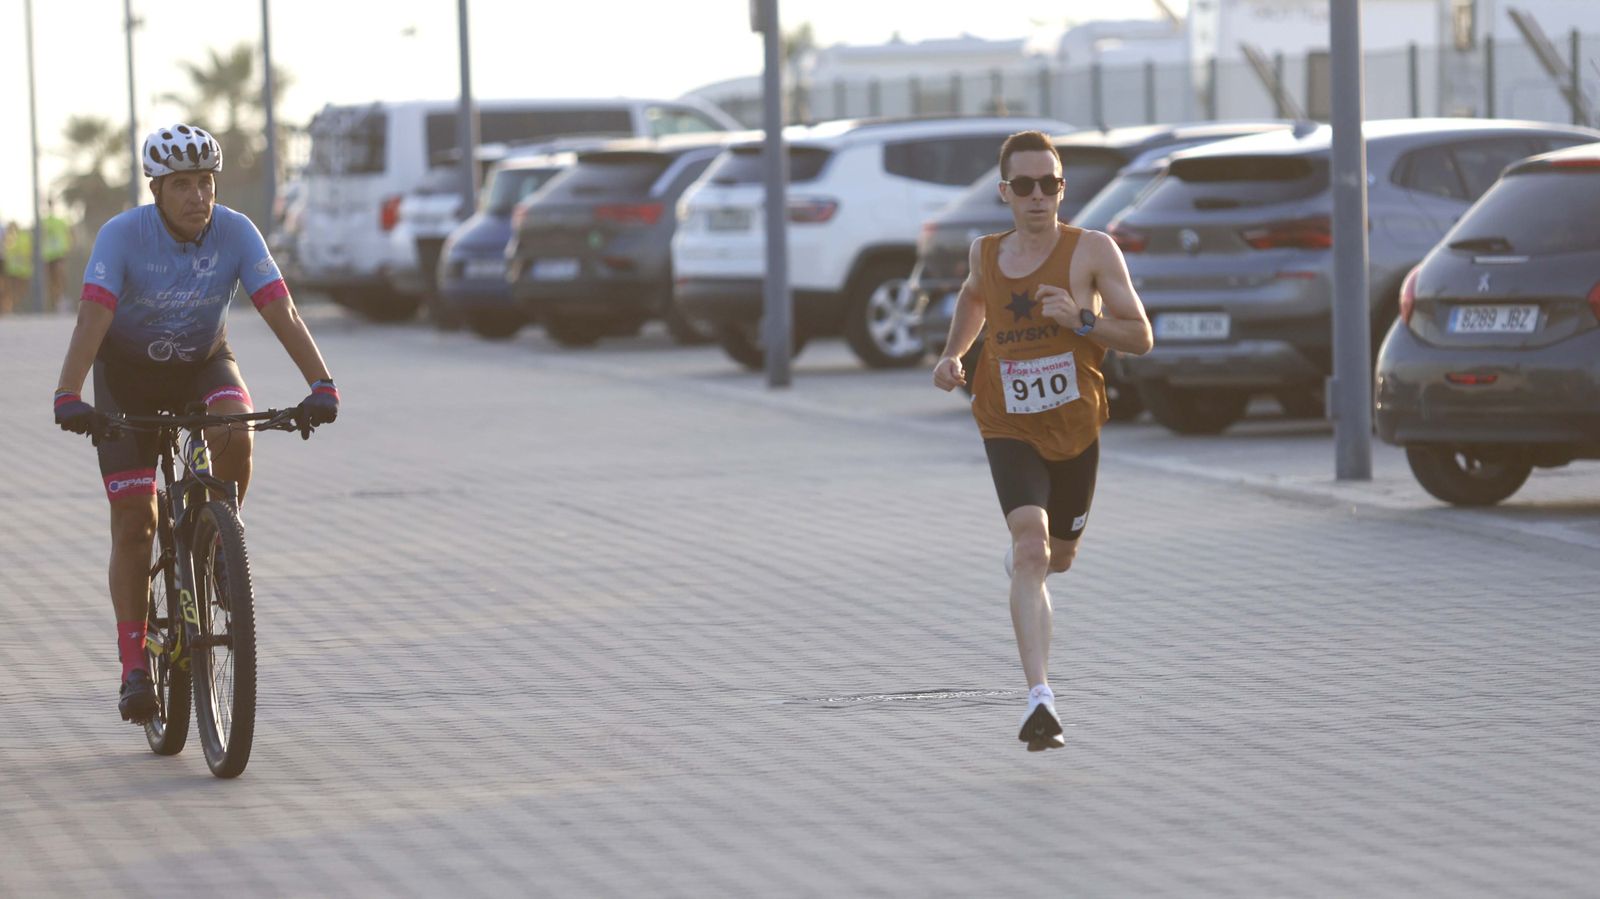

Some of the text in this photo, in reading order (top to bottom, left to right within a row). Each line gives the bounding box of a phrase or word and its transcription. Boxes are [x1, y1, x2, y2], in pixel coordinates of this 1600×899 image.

[1461, 308, 1531, 329] 8289 JBZ
[996, 325, 1059, 345] SAYSKY
[1029, 367, 1041, 375] LA
[1012, 373, 1068, 401] 910
